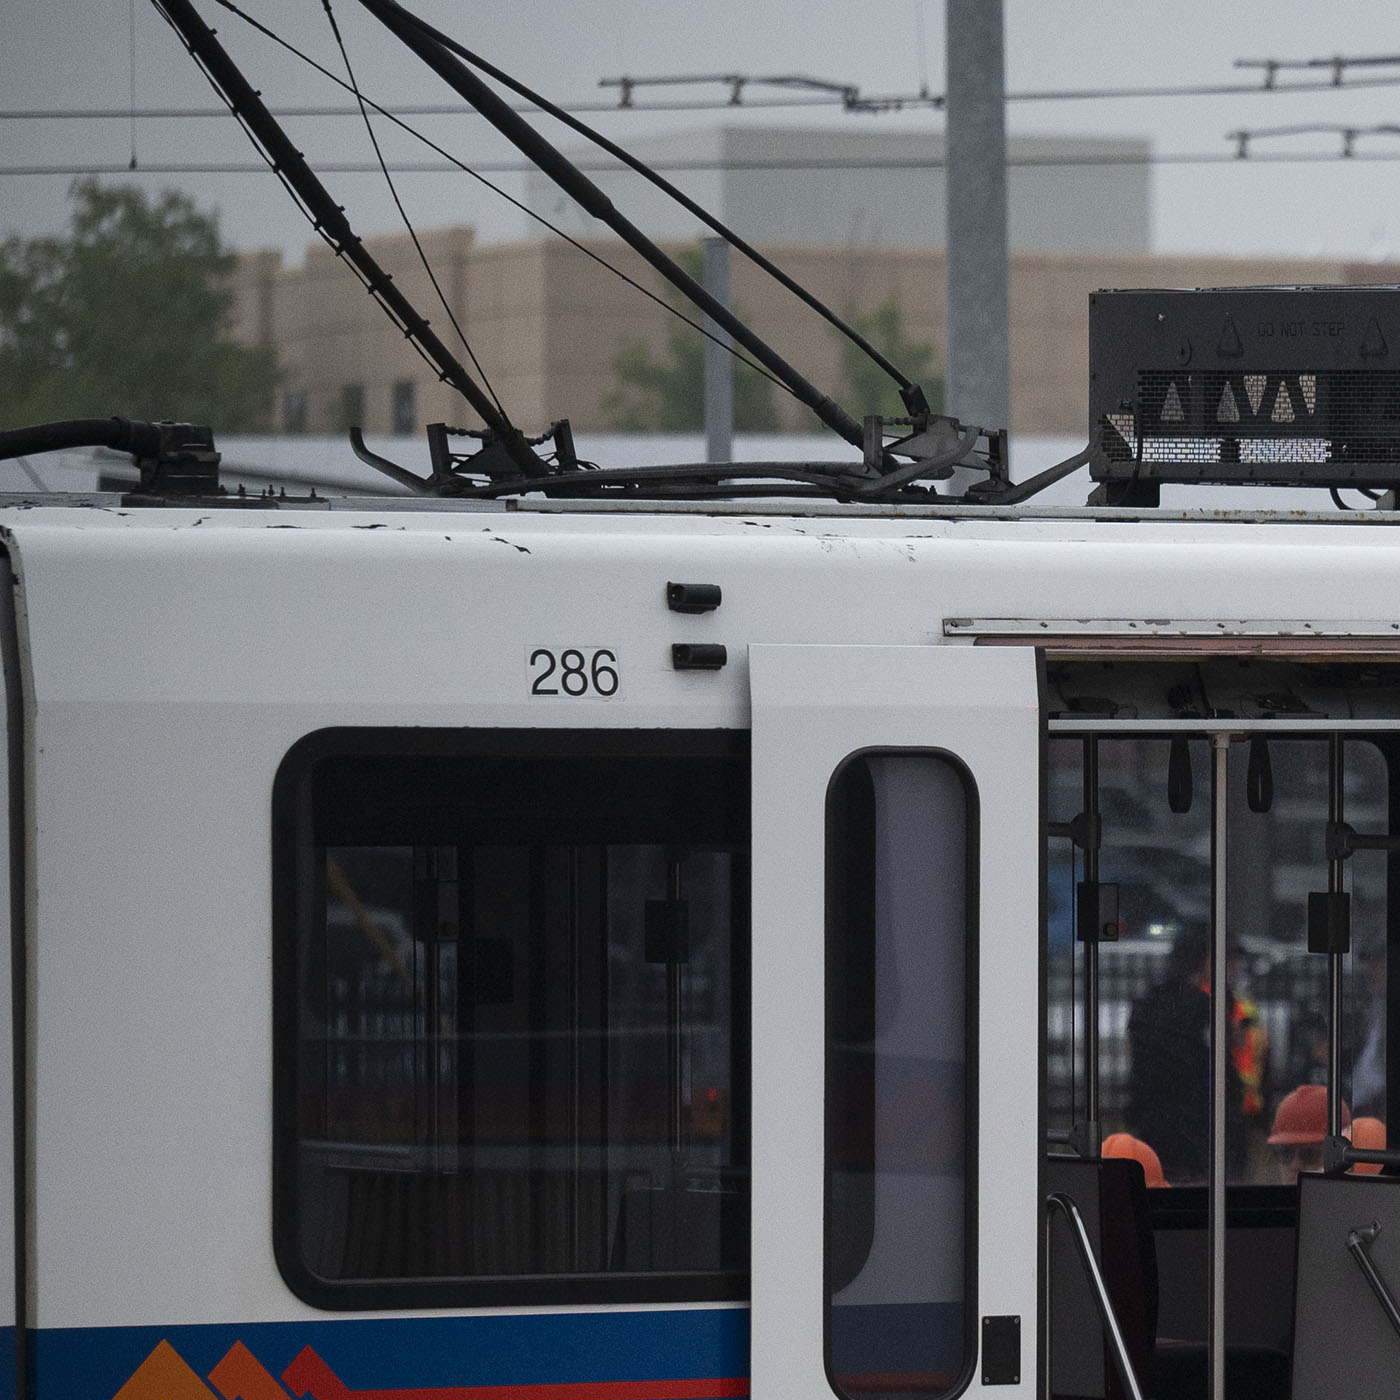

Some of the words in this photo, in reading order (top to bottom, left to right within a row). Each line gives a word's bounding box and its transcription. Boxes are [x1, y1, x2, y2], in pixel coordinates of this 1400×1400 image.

[1281, 322, 1304, 337] NOT
[1313, 322, 1345, 337] STEP
[530, 649, 619, 697] 286
